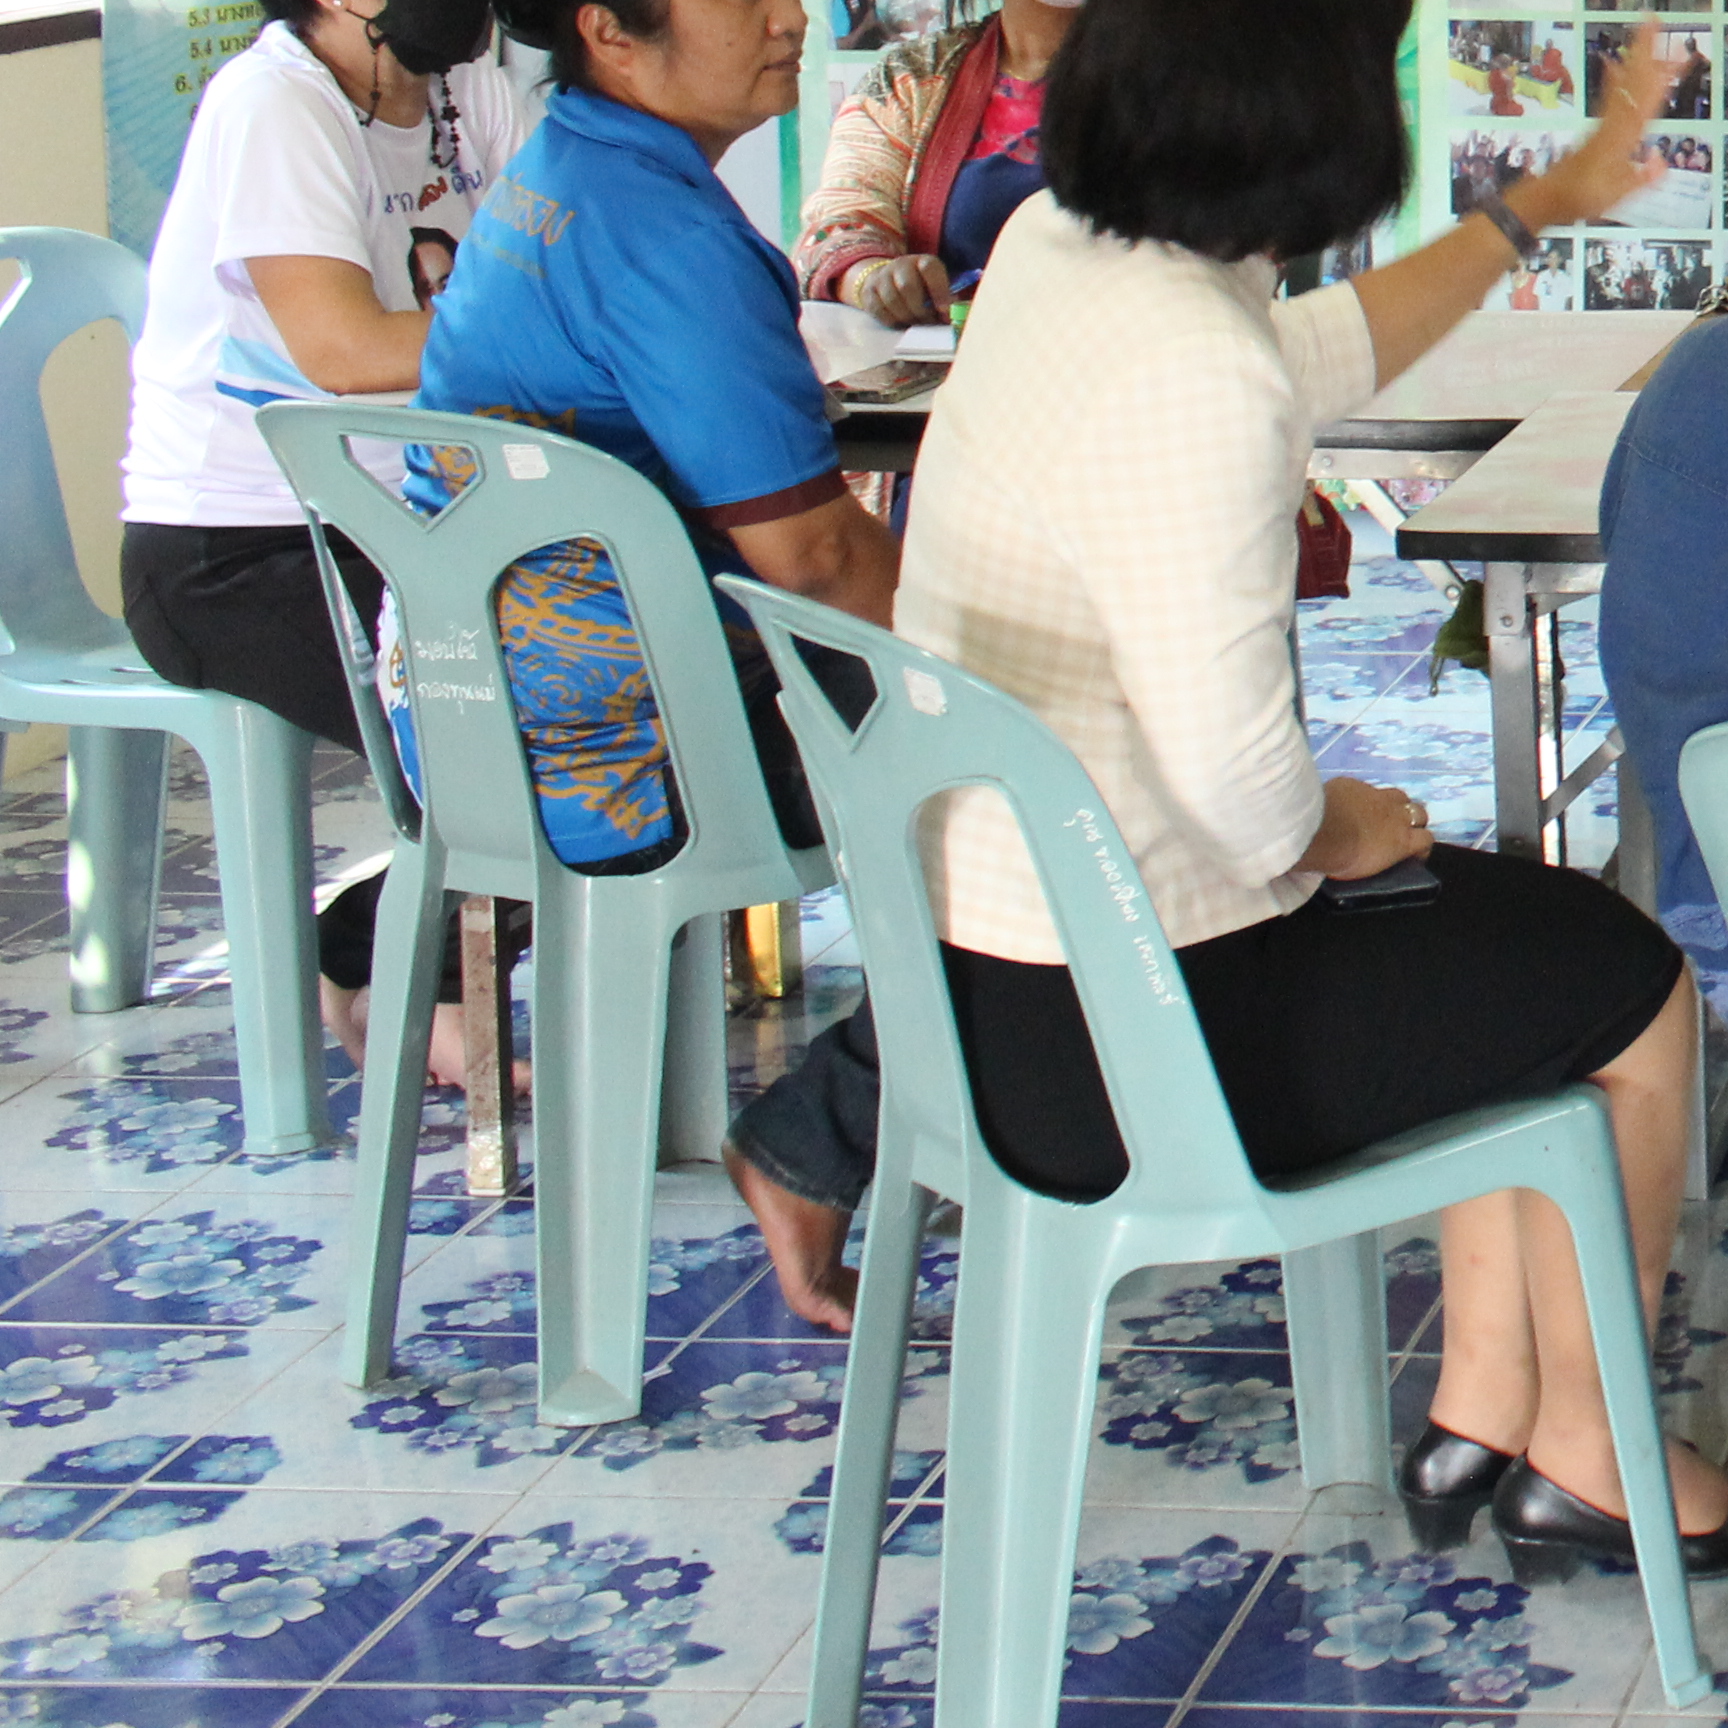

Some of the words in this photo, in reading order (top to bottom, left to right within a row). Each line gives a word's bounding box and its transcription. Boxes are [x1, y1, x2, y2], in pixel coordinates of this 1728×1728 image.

[188, 9, 212, 27] 5.3
[190, 39, 214, 59] 5.4
[175, 75, 193, 94] 6.
